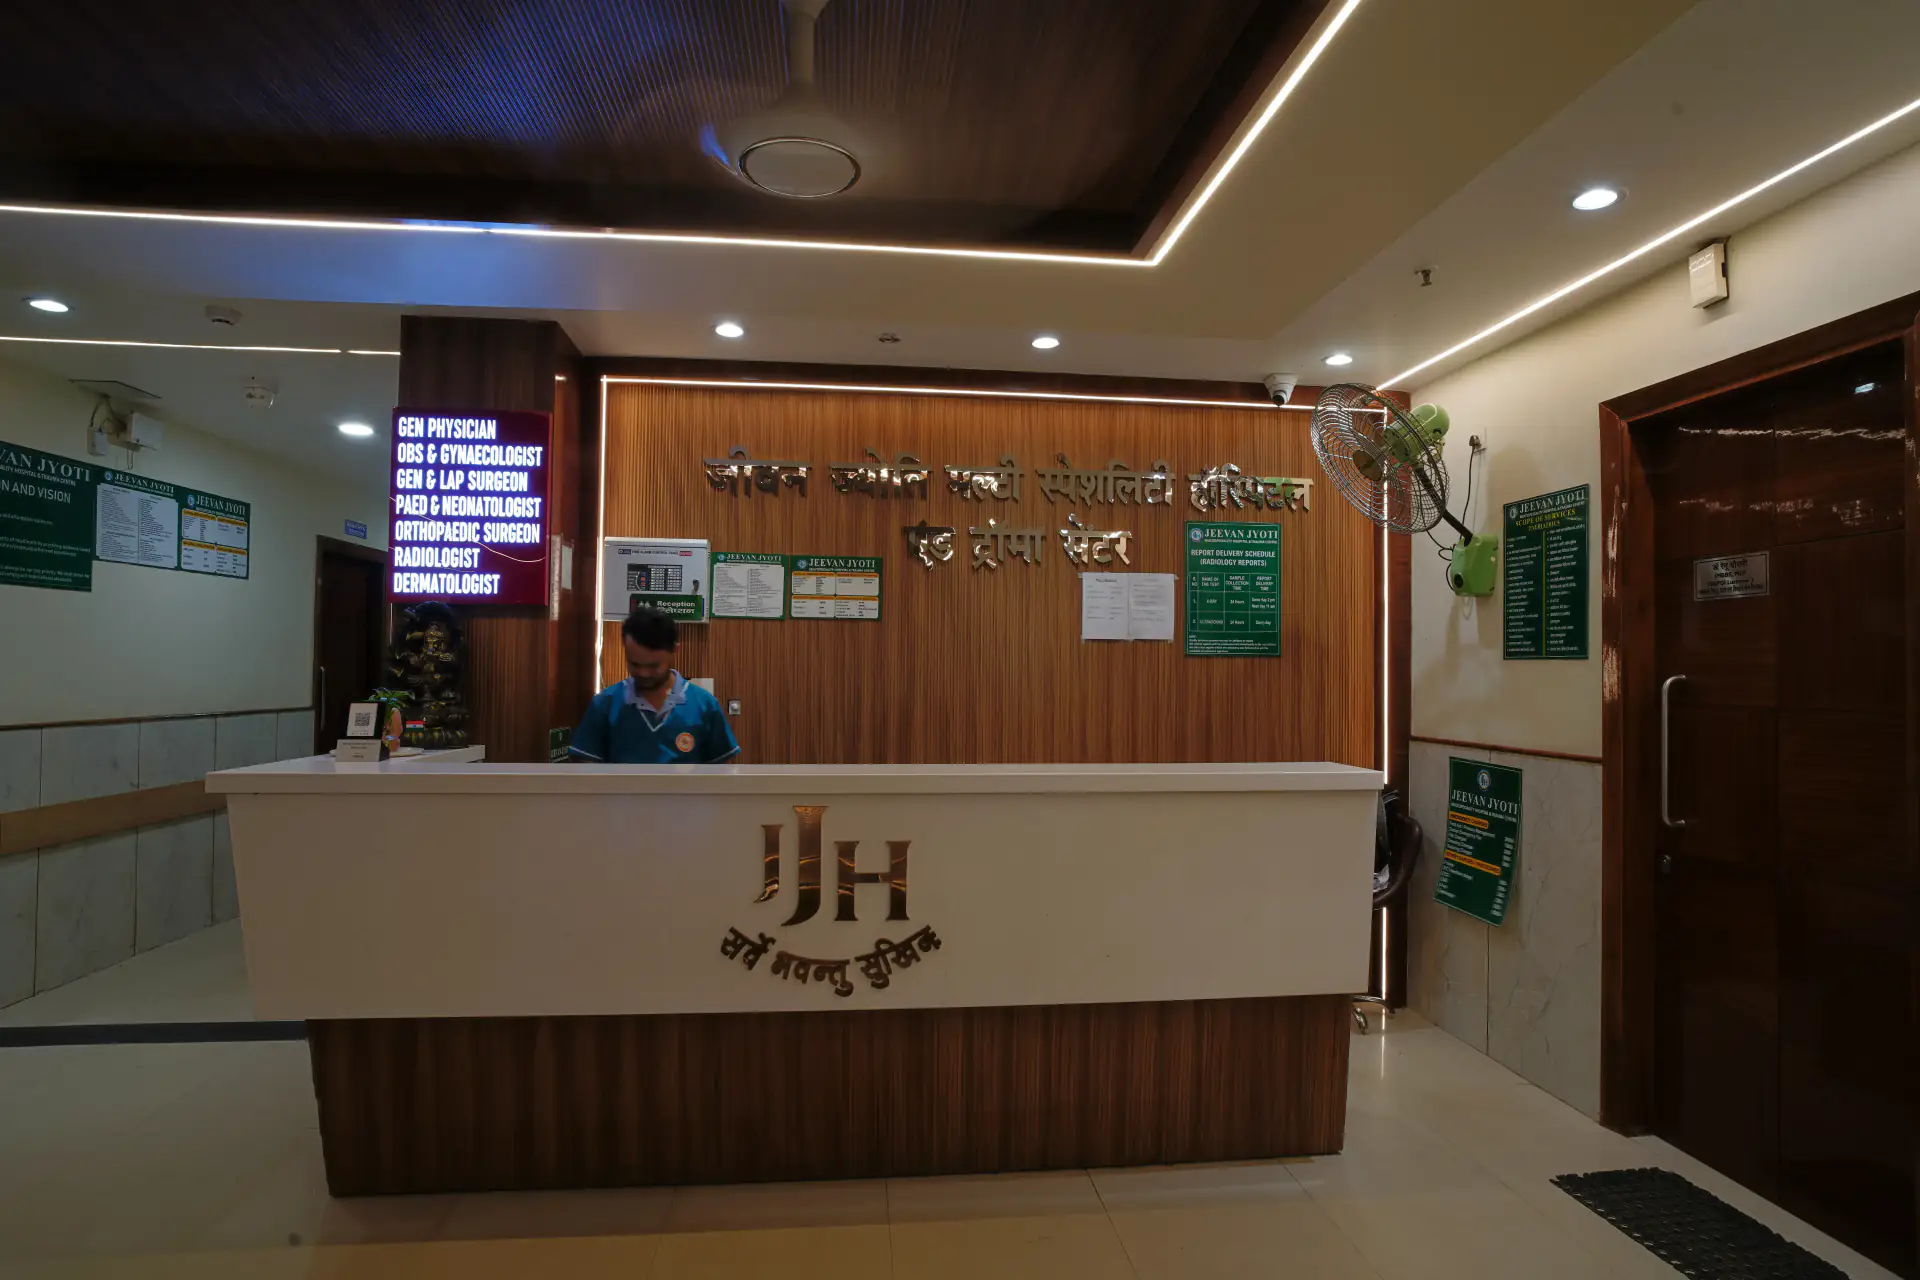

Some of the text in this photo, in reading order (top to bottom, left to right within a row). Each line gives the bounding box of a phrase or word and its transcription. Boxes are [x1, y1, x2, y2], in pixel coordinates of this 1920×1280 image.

[398, 417, 497, 439] GEN PHYSICIAN
[397, 443, 543, 467] OBS & GYNAECOLOGIST
[37, 458, 90, 481] JYOTI
[396, 469, 528, 492] GEN & LAP SURGEON
[704, 445, 812, 497] जीवन
[829, 446, 932, 499] ज्योति
[944, 454, 1024, 503] मल्टी
[1035, 453, 1177, 507] स्पेशलिटी
[11, 481, 35, 497] AND
[37, 486, 71, 504] VISION
[114, 473, 175, 493] JEEVAN JYOTI
[196, 495, 245, 514] JEEVAN JYOTI
[395, 495, 542, 518] PAED & NEONATOLOGIST
[1520, 490, 1585, 513] JEEVAN JYOTI
[1515, 515, 1536, 526] SCOPE
[1544, 509, 1576, 520] SERVICES
[395, 521, 540, 543] ORTHOPAEDIC SURGEON
[969, 518, 1046, 570] ट्रामा
[1057, 513, 1132, 565] सेंटर
[1205, 529, 1278, 539] JEEVAN JYOTI
[394, 547, 480, 569] RADIOLOGIST
[808, 559, 875, 568] JEEVAN JYOTI
[1200, 558, 1267, 567] (RADIOLOGY REPORTS)
[393, 573, 500, 595] DERMATOLOGIST
[1452, 790, 1518, 815] JEEVAN JYOTI
[720, 927, 776, 970] सर्वे
[771, 951, 854, 997] भवन्तु
